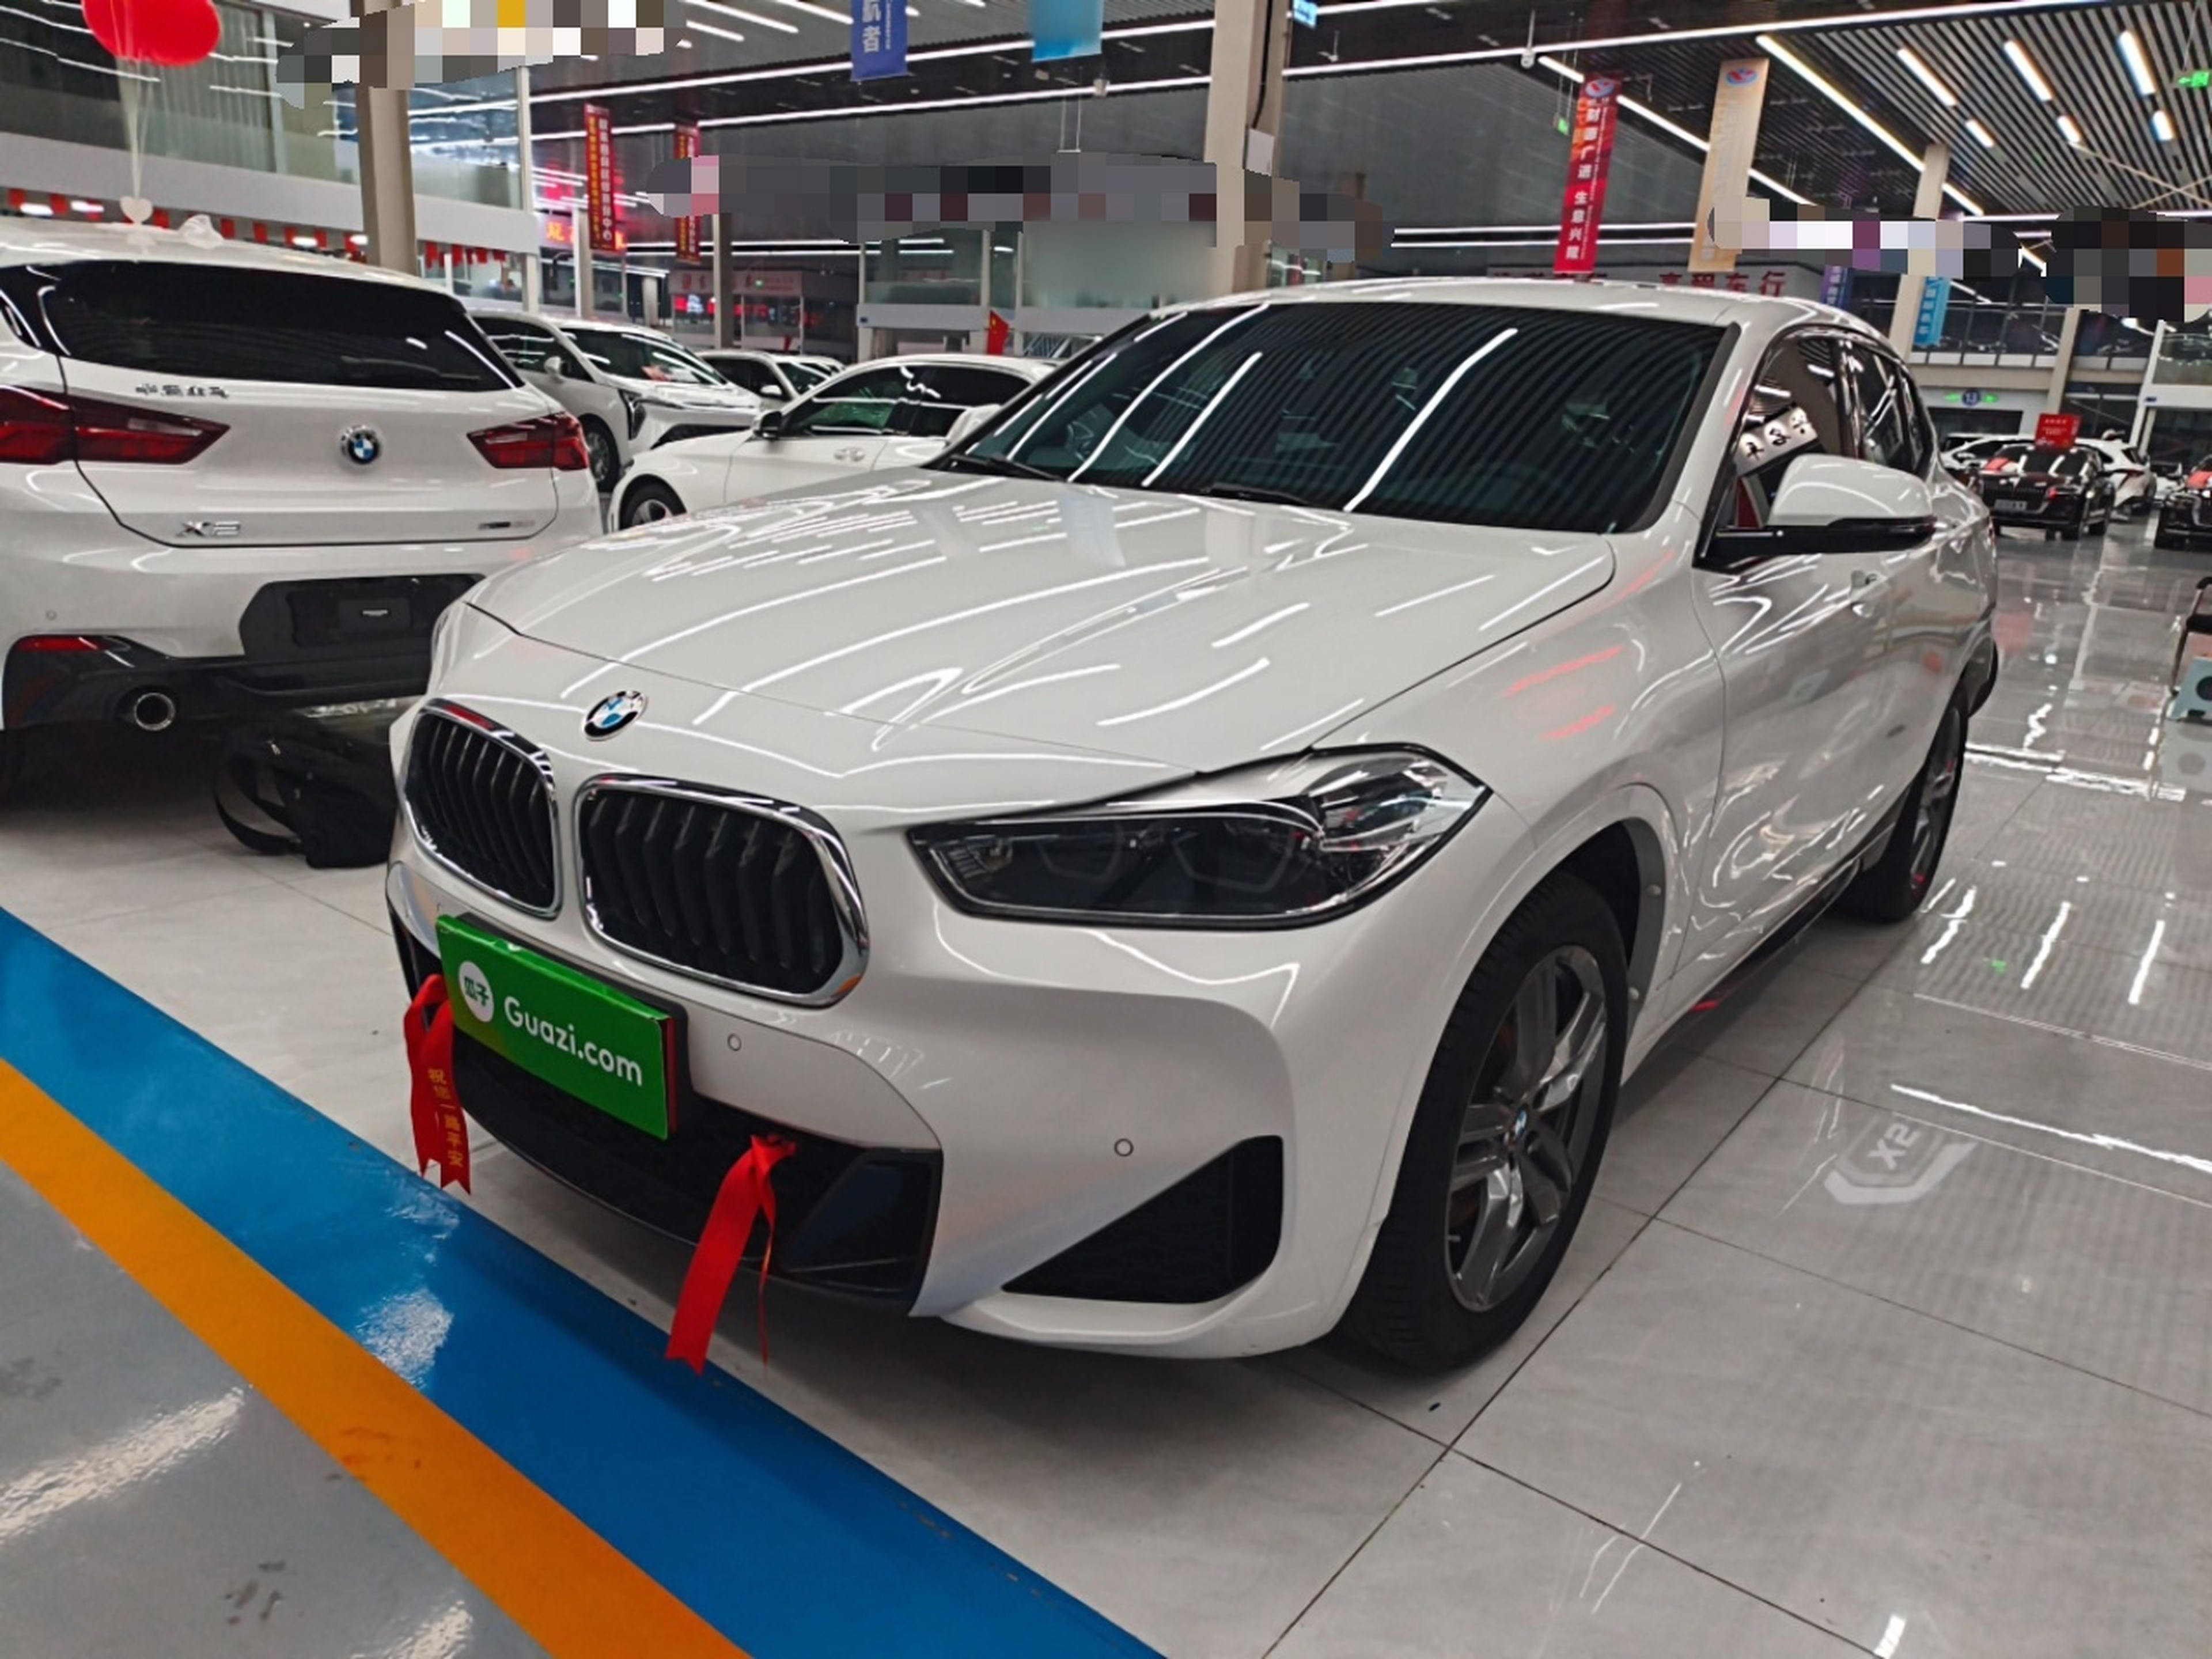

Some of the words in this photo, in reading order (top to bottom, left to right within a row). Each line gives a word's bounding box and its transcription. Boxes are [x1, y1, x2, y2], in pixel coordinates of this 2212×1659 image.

[176, 520, 242, 537] X2
[464, 976, 490, 1007] 瓜子
[504, 995, 643, 1086] Guazi.com
[1866, 1122, 1922, 1171] X2
